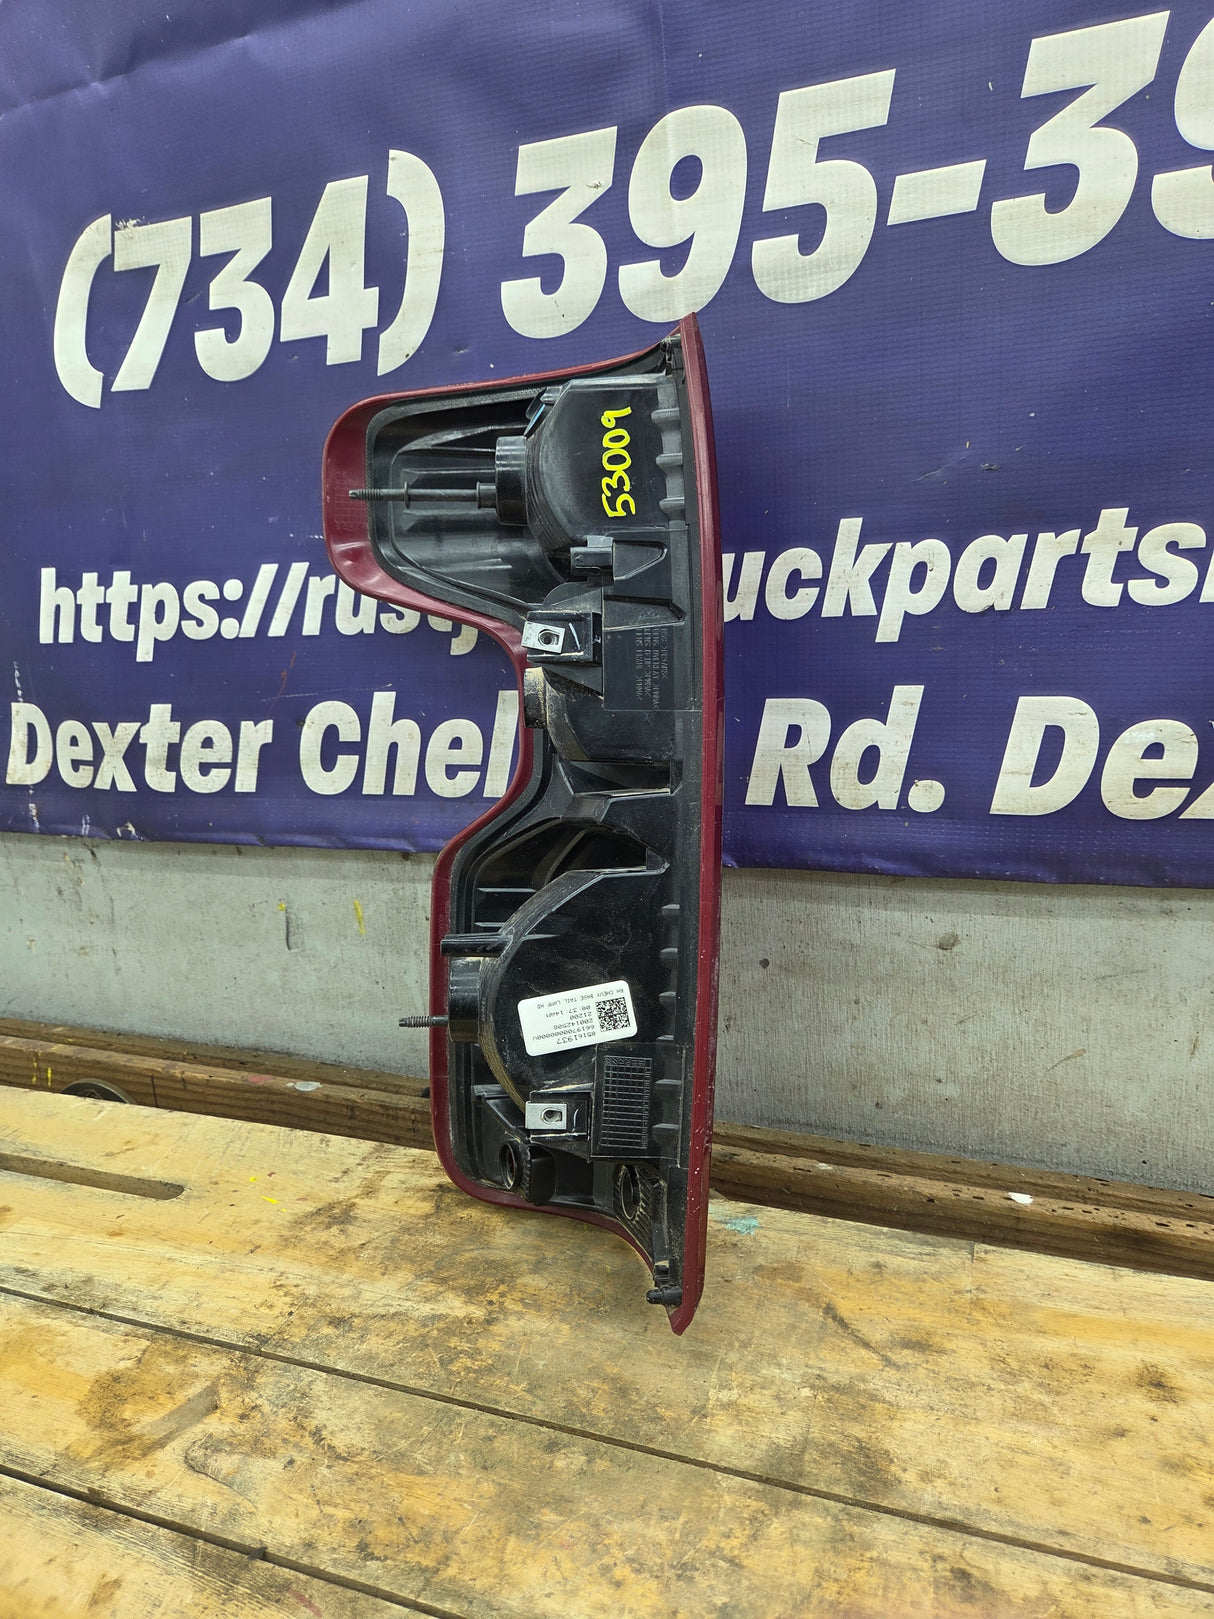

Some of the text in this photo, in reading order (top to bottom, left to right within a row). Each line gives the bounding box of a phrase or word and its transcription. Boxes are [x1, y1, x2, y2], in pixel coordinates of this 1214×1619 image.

[53, 150, 445, 409] (734)
[600, 406, 636, 518] 53009
[722, 508, 1214, 642] uckparts
[6, 702, 273, 793] Dexter
[745, 685, 945, 812] Rd.
